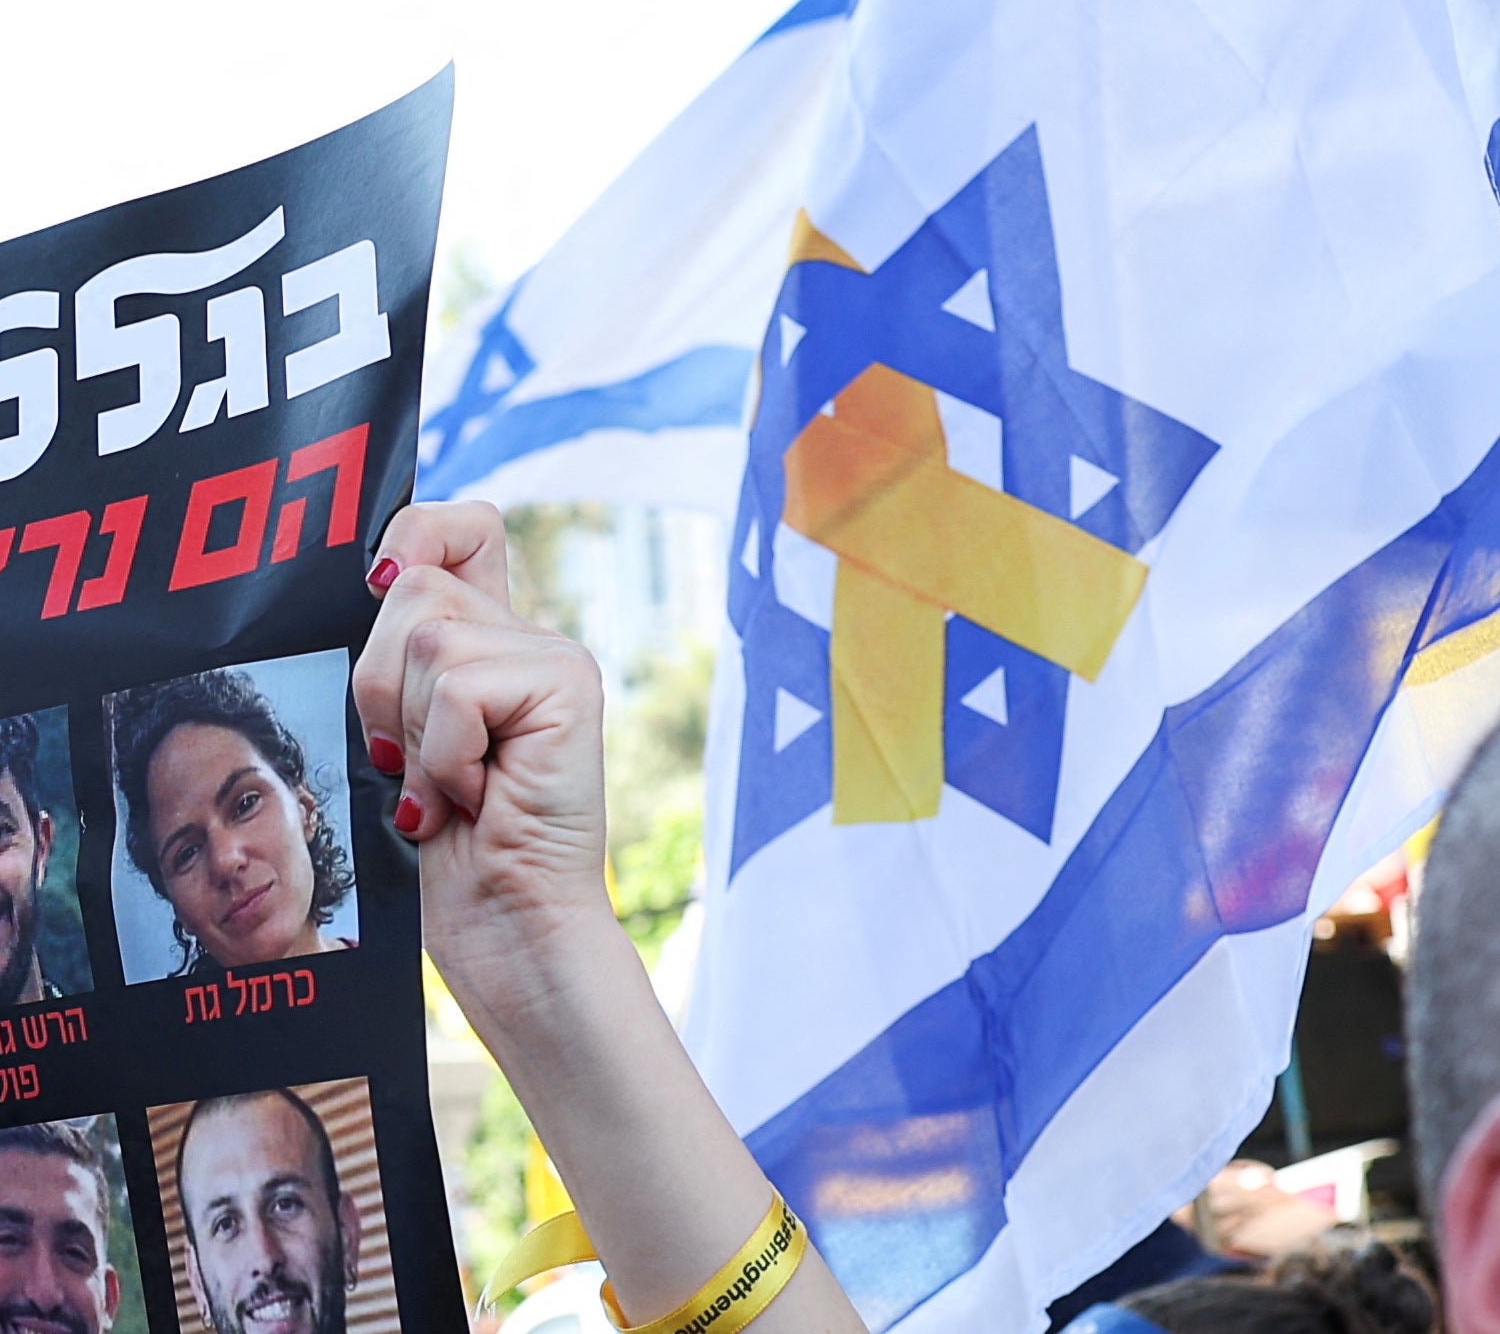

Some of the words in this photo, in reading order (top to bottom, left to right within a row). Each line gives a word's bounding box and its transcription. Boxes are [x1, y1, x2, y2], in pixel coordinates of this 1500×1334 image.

[167, 421, 372, 593] הם
[184, 983, 223, 1024] גת
[225, 968, 317, 1016] כרמל
[20, 1006, 89, 1051] הרש
